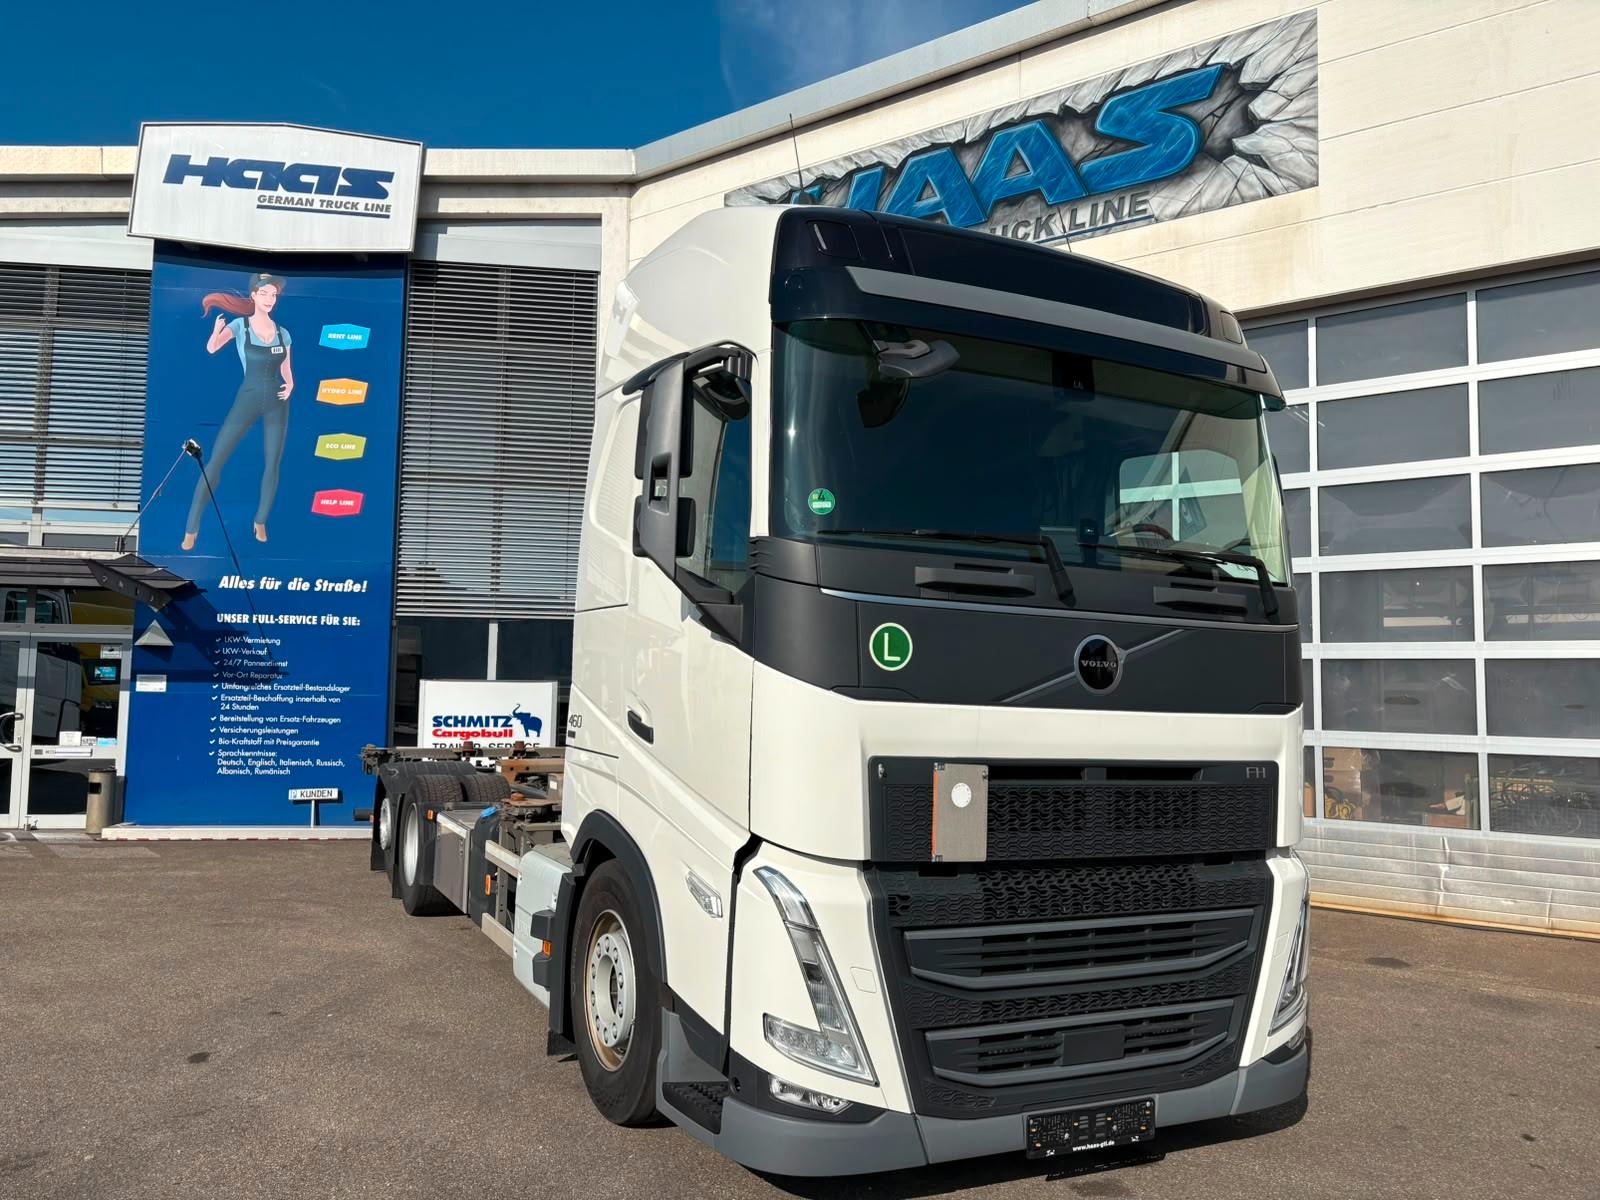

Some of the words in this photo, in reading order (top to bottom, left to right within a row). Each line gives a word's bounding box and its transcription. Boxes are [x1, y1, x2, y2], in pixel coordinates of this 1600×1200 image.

[257, 194, 314, 207] GERMAN
[319, 198, 359, 211] TRUCK
[364, 202, 392, 214] LINE
[1069, 190, 1151, 231] LINE
[218, 575, 255, 590] Alles
[259, 576, 282, 591] für
[287, 577, 311, 591] die
[314, 579, 368, 592] Straße!
[216, 613, 249, 623] UNSER
[252, 613, 317, 625] FULL-SERVICE
[320, 613, 340, 625] FÜR
[342, 615, 361, 626] SIE:
[224, 636, 281, 646] LKW-Vermietung
[222, 647, 268, 656] LKW-Verkauf
[883, 632, 901, 661] L
[223, 659, 242, 667] 24/7
[1081, 659, 1117, 669] VOLVO
[222, 671, 249, 679] Vor-Ort
[273, 684, 351, 694] Ersatzteil-Bestandslager
[220, 694, 294, 704] Ersatzteil-Beschaffung
[295, 695, 327, 704] innerhalb
[220, 703, 230, 711] 24
[231, 703, 259, 711] Stunden
[219, 714, 264, 724] Bereitstellung
[279, 715, 342, 725] Ersatz-Fahrzeugen
[432, 715, 514, 728] SCHMITZ
[569, 714, 583, 729] 460
[218, 726, 299, 736] Versicherungsleistungen
[432, 728, 514, 741] Cargobull
[218, 737, 262, 746] Bio-Kraftstoff
[263, 738, 275, 746] mit
[275, 738, 320, 748] Preisgarantie
[217, 749, 278, 759] Sprachkenntnisse:
[217, 758, 246, 767] Deutsch,
[247, 758, 278, 768] Englisch,
[279, 758, 315, 768] Italienisch,
[316, 759, 346, 768] Russisch,
[216, 767, 253, 776] Albanisch,
[254, 767, 291, 776] Rumänisch
[1246, 767, 1266, 778] FH
[300, 789, 333, 798] KUNDEN
